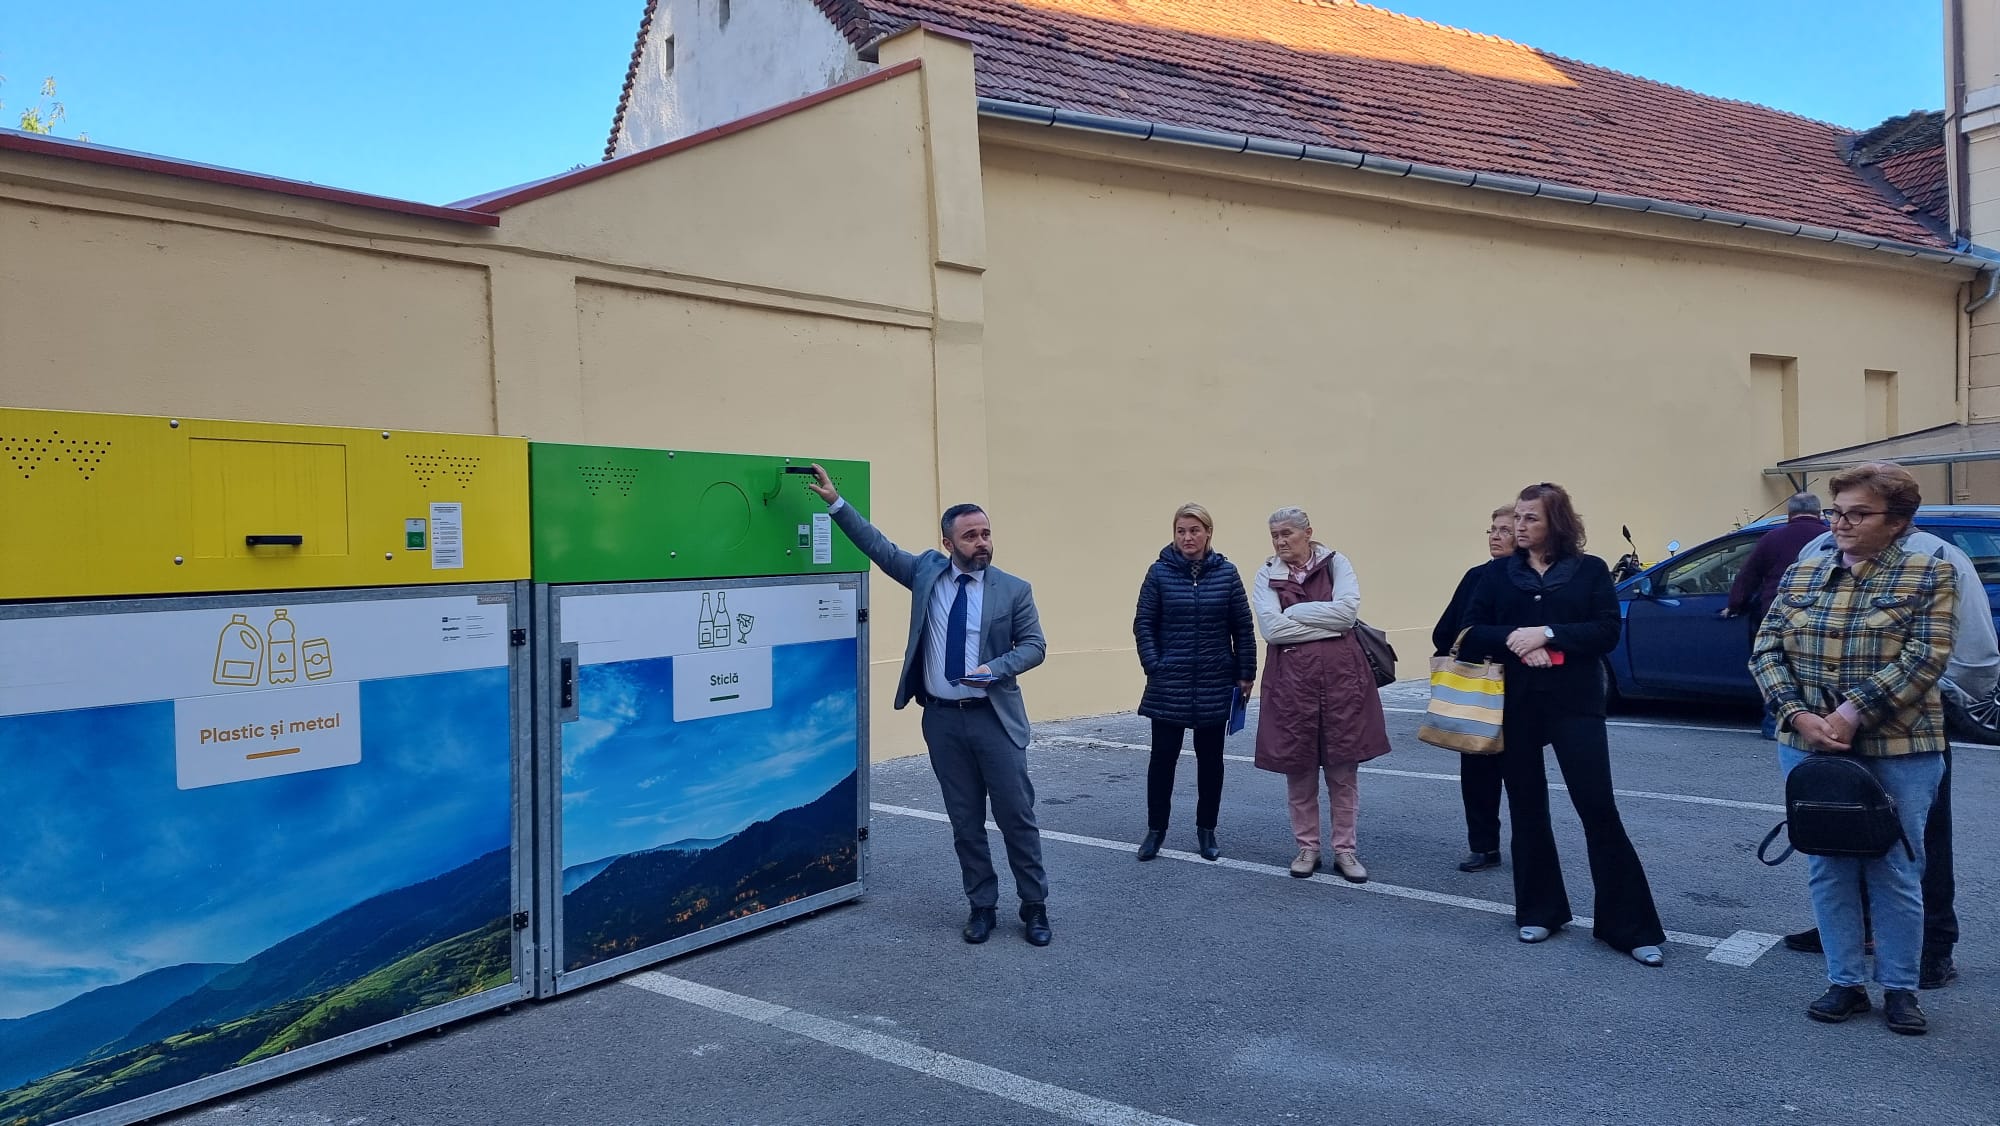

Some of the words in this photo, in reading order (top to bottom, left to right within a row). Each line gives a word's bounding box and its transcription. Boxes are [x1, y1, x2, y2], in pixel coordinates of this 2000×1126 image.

[710, 672, 739, 686] Sticlă
[200, 723, 265, 745] Plastic
[270, 719, 284, 741] și
[289, 712, 340, 734] metal
